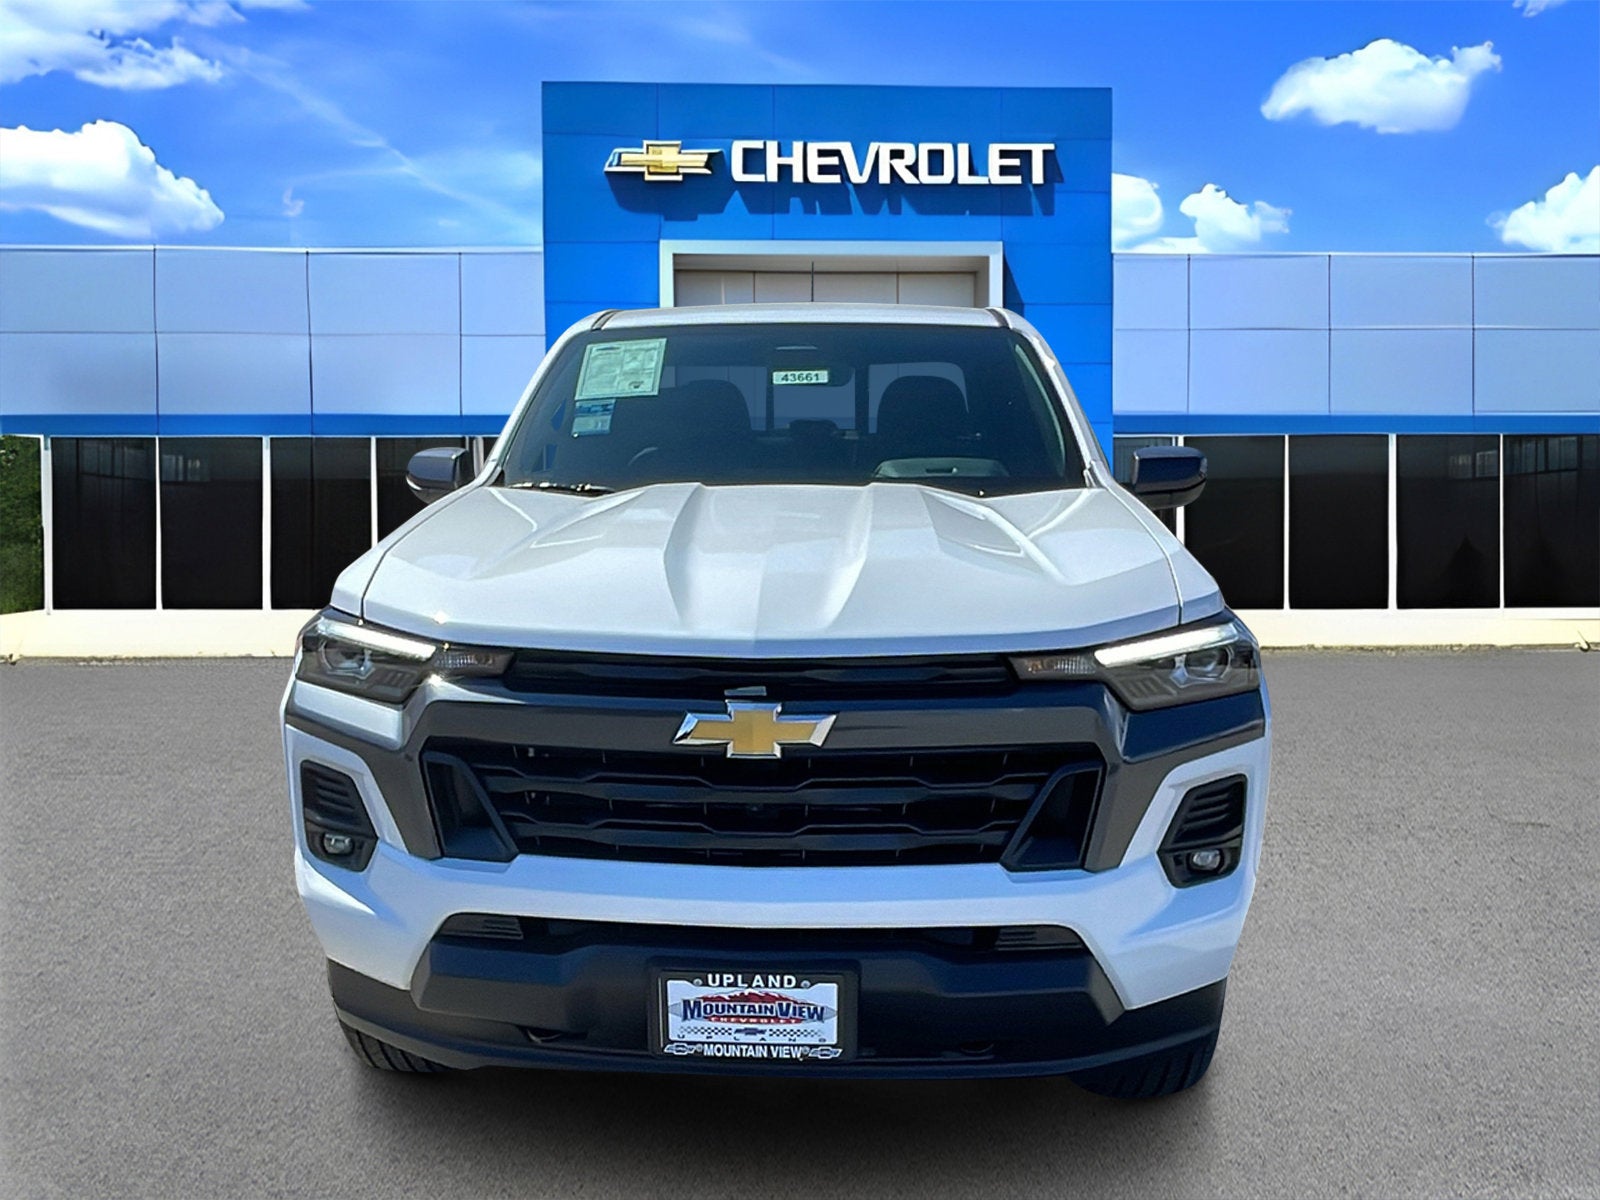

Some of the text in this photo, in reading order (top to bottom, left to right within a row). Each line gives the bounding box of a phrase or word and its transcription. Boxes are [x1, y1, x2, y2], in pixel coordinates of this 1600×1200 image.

[730, 140, 1056, 185] CHEVROLET
[781, 372, 820, 382] 43661
[707, 973, 797, 988] UPLAND
[681, 999, 826, 1023] MOUNTAIN VIEW
[711, 1016, 797, 1024] CHEVROLET
[703, 1044, 803, 1059] MOUNTAIN VIEW
